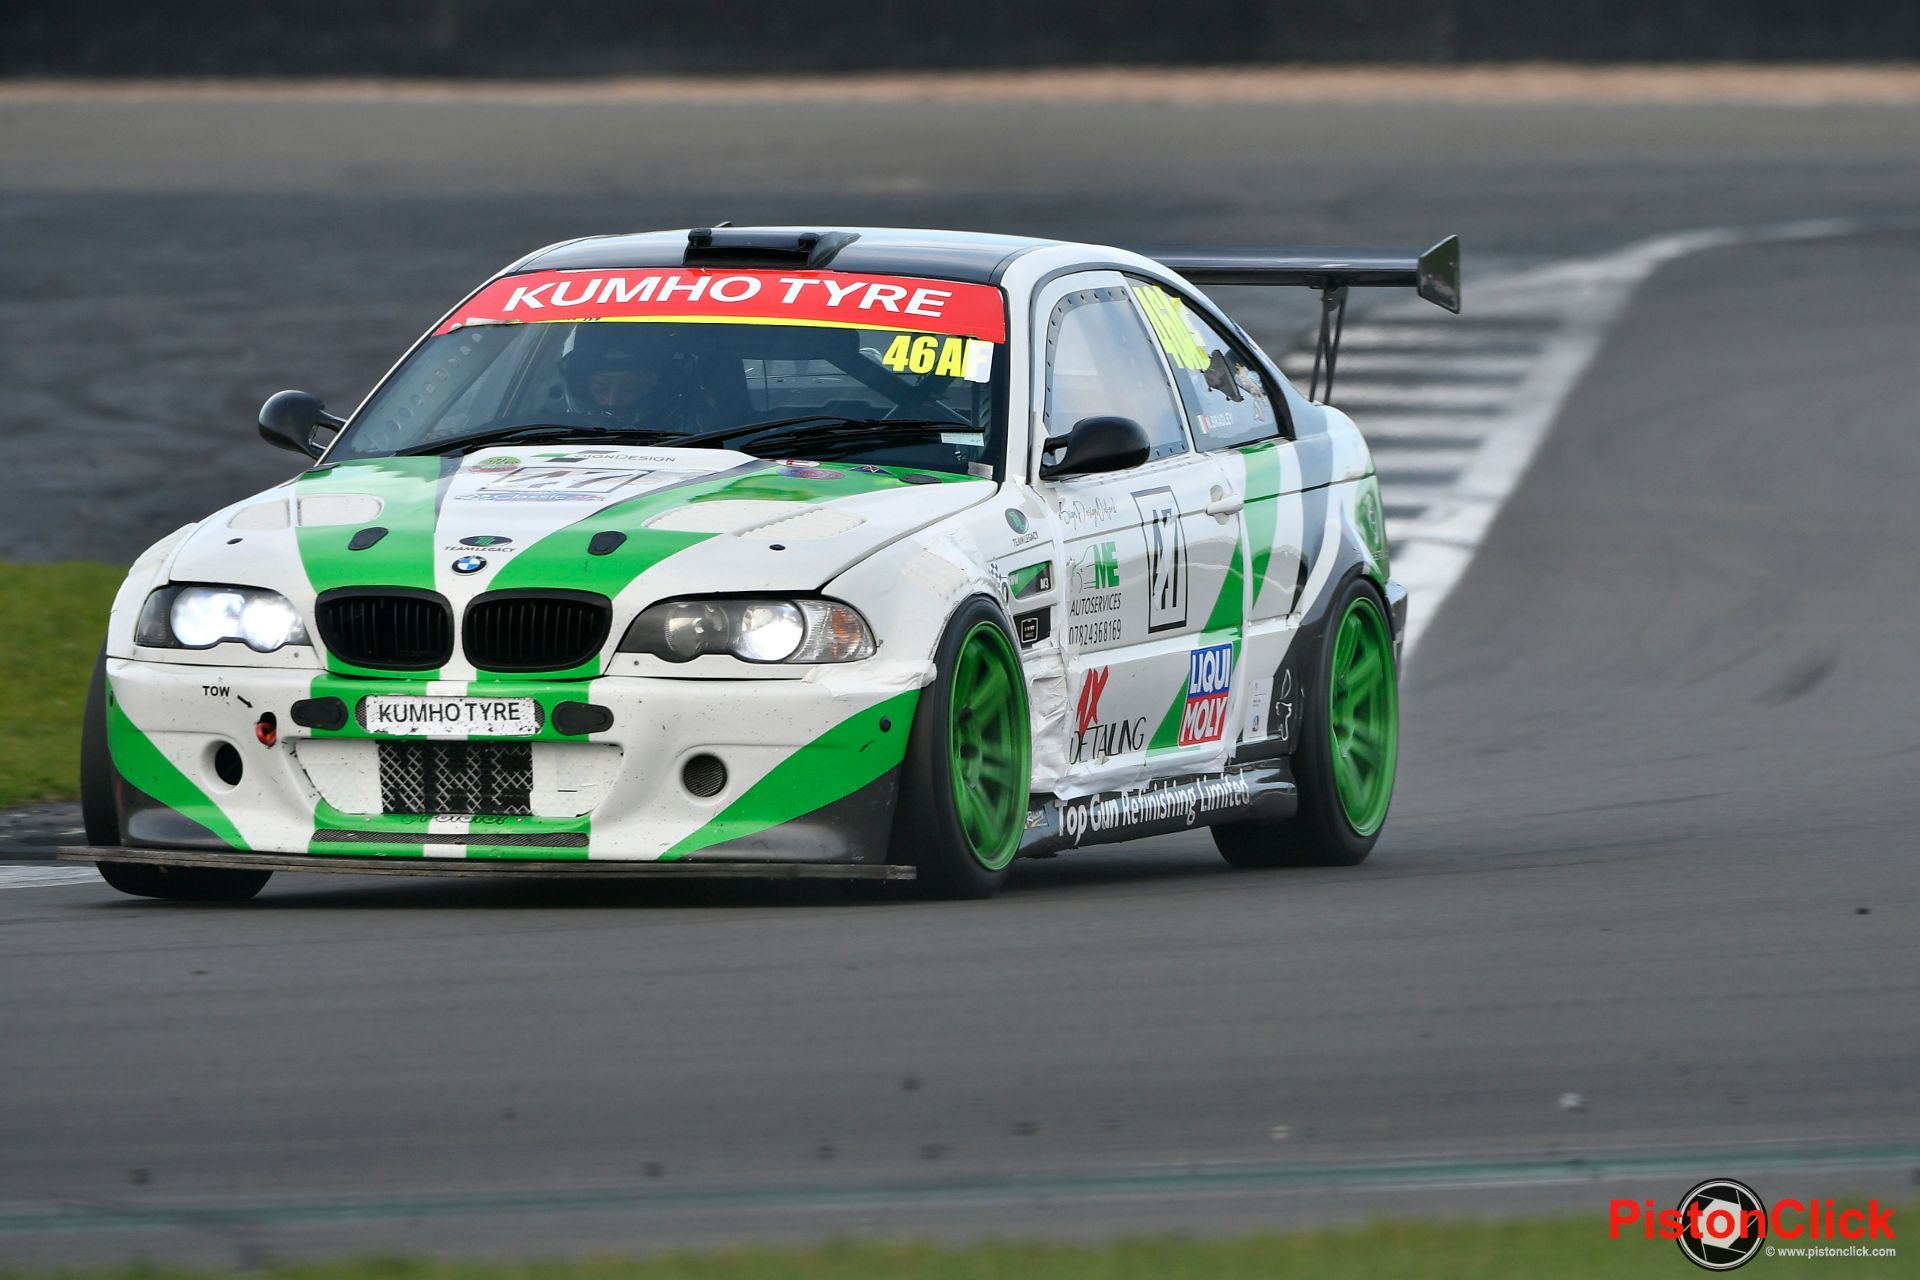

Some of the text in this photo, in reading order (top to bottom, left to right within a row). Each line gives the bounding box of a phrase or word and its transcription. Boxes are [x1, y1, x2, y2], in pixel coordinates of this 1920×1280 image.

[503, 275, 953, 319] KUMHO TYRE
[882, 335, 989, 380] 46A
[1069, 592, 1122, 617] AUTOSERVICES
[1068, 618, 1122, 647] 07824368169
[202, 685, 231, 698] TOW
[1189, 648, 1231, 694] LIQUI
[379, 702, 521, 722] KUMHO TYRE
[1180, 696, 1229, 743] MOLY
[1055, 768, 1251, 846] Top Gun Refinishing Limited
